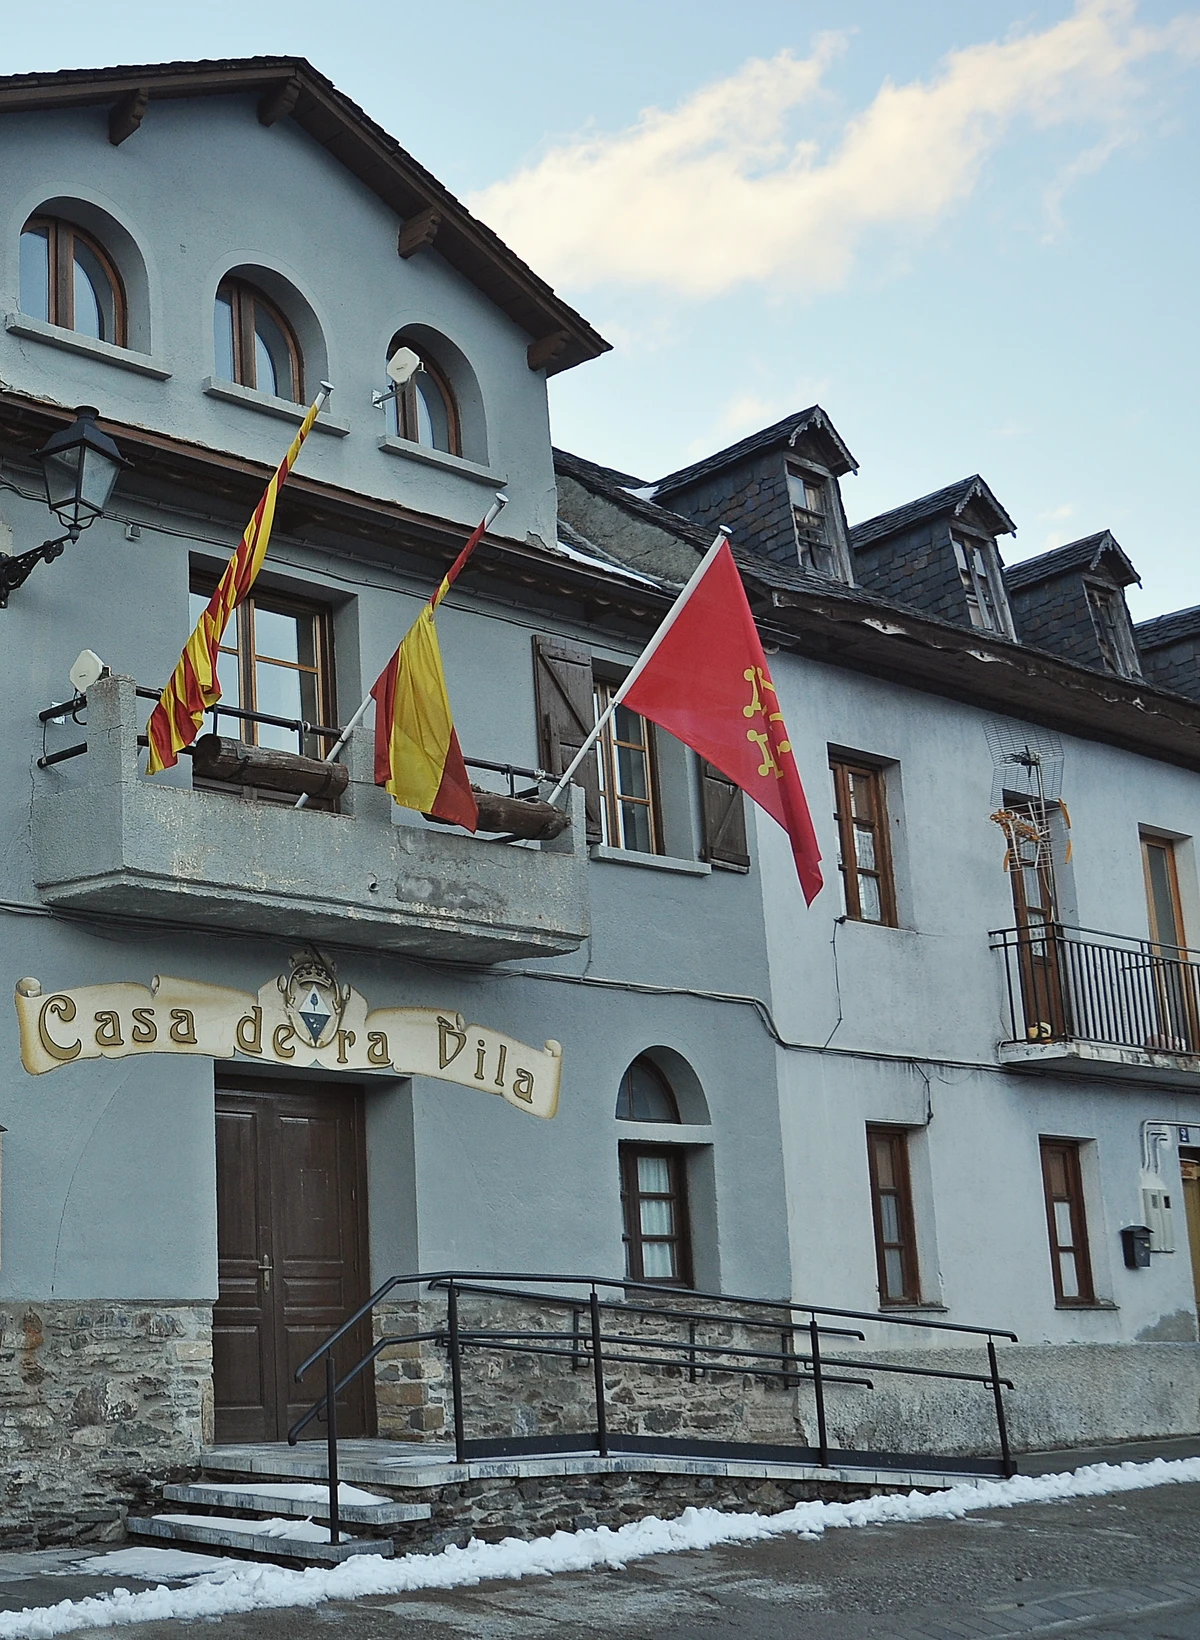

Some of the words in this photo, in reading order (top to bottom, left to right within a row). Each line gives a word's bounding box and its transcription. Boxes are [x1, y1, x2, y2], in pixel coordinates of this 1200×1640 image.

[38, 994, 198, 1061] Casa
[236, 1005, 296, 1058] de
[336, 1029, 391, 1065] ra
[437, 1015, 535, 1104] Vila
